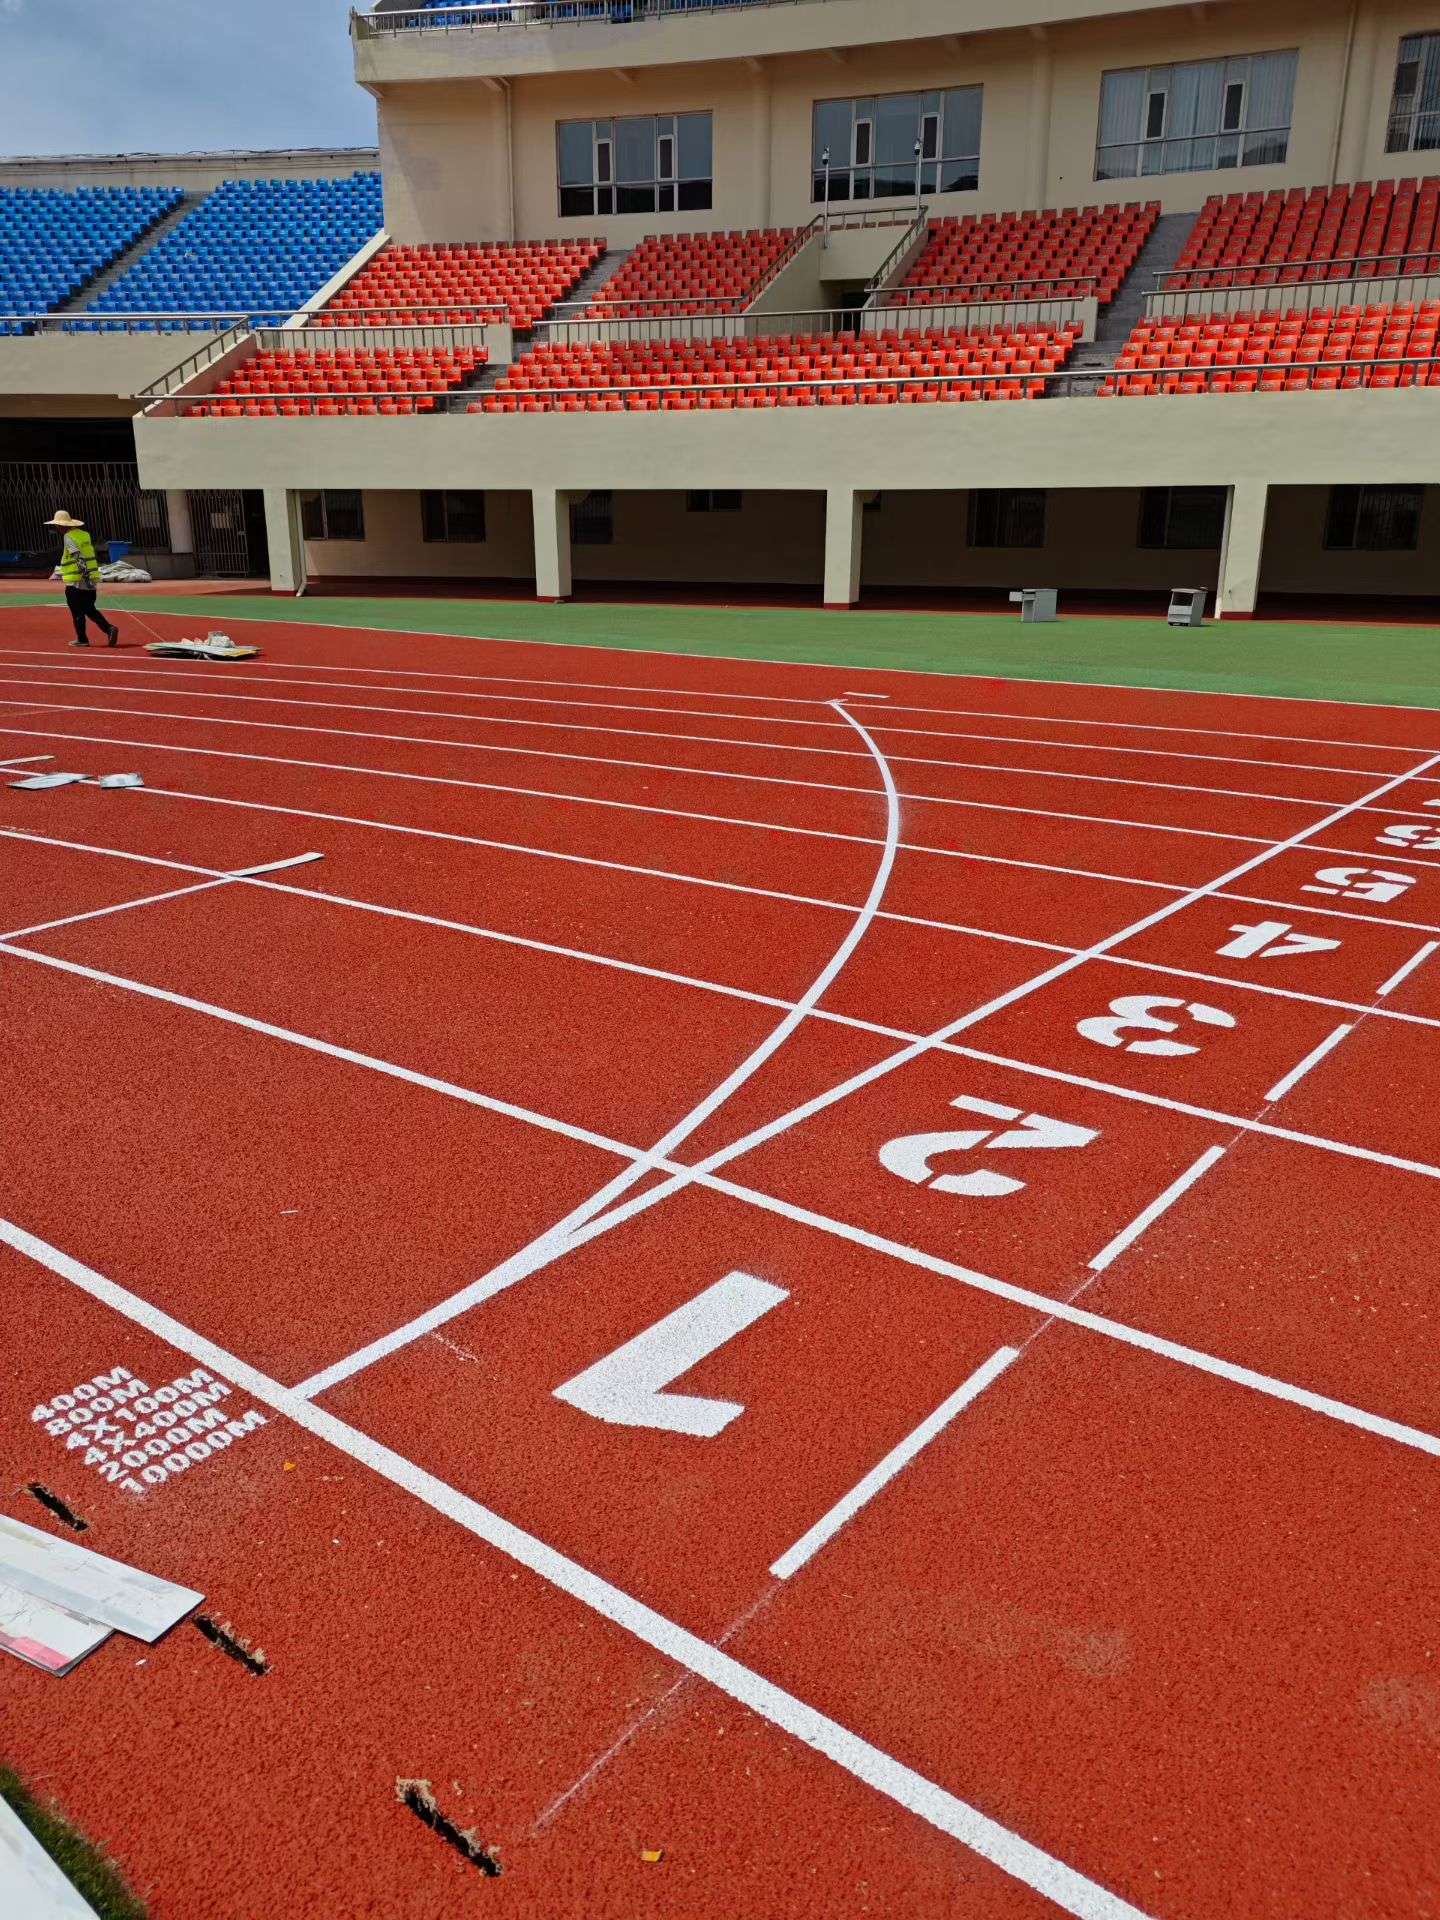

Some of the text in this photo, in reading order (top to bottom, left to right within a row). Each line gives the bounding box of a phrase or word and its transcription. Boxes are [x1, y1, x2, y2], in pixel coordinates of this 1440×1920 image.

[1301, 868, 1417, 902] 5
[1216, 921, 1342, 958] 4
[1076, 996, 1237, 1056] 3
[878, 1095, 1101, 1197] 2
[552, 1271, 791, 1438] 1
[32, 1366, 132, 1422] 400M
[45, 1379, 150, 1436] 800M
[98, 1407, 229, 1483] 2000M
[119, 1410, 269, 1495] 10000M
